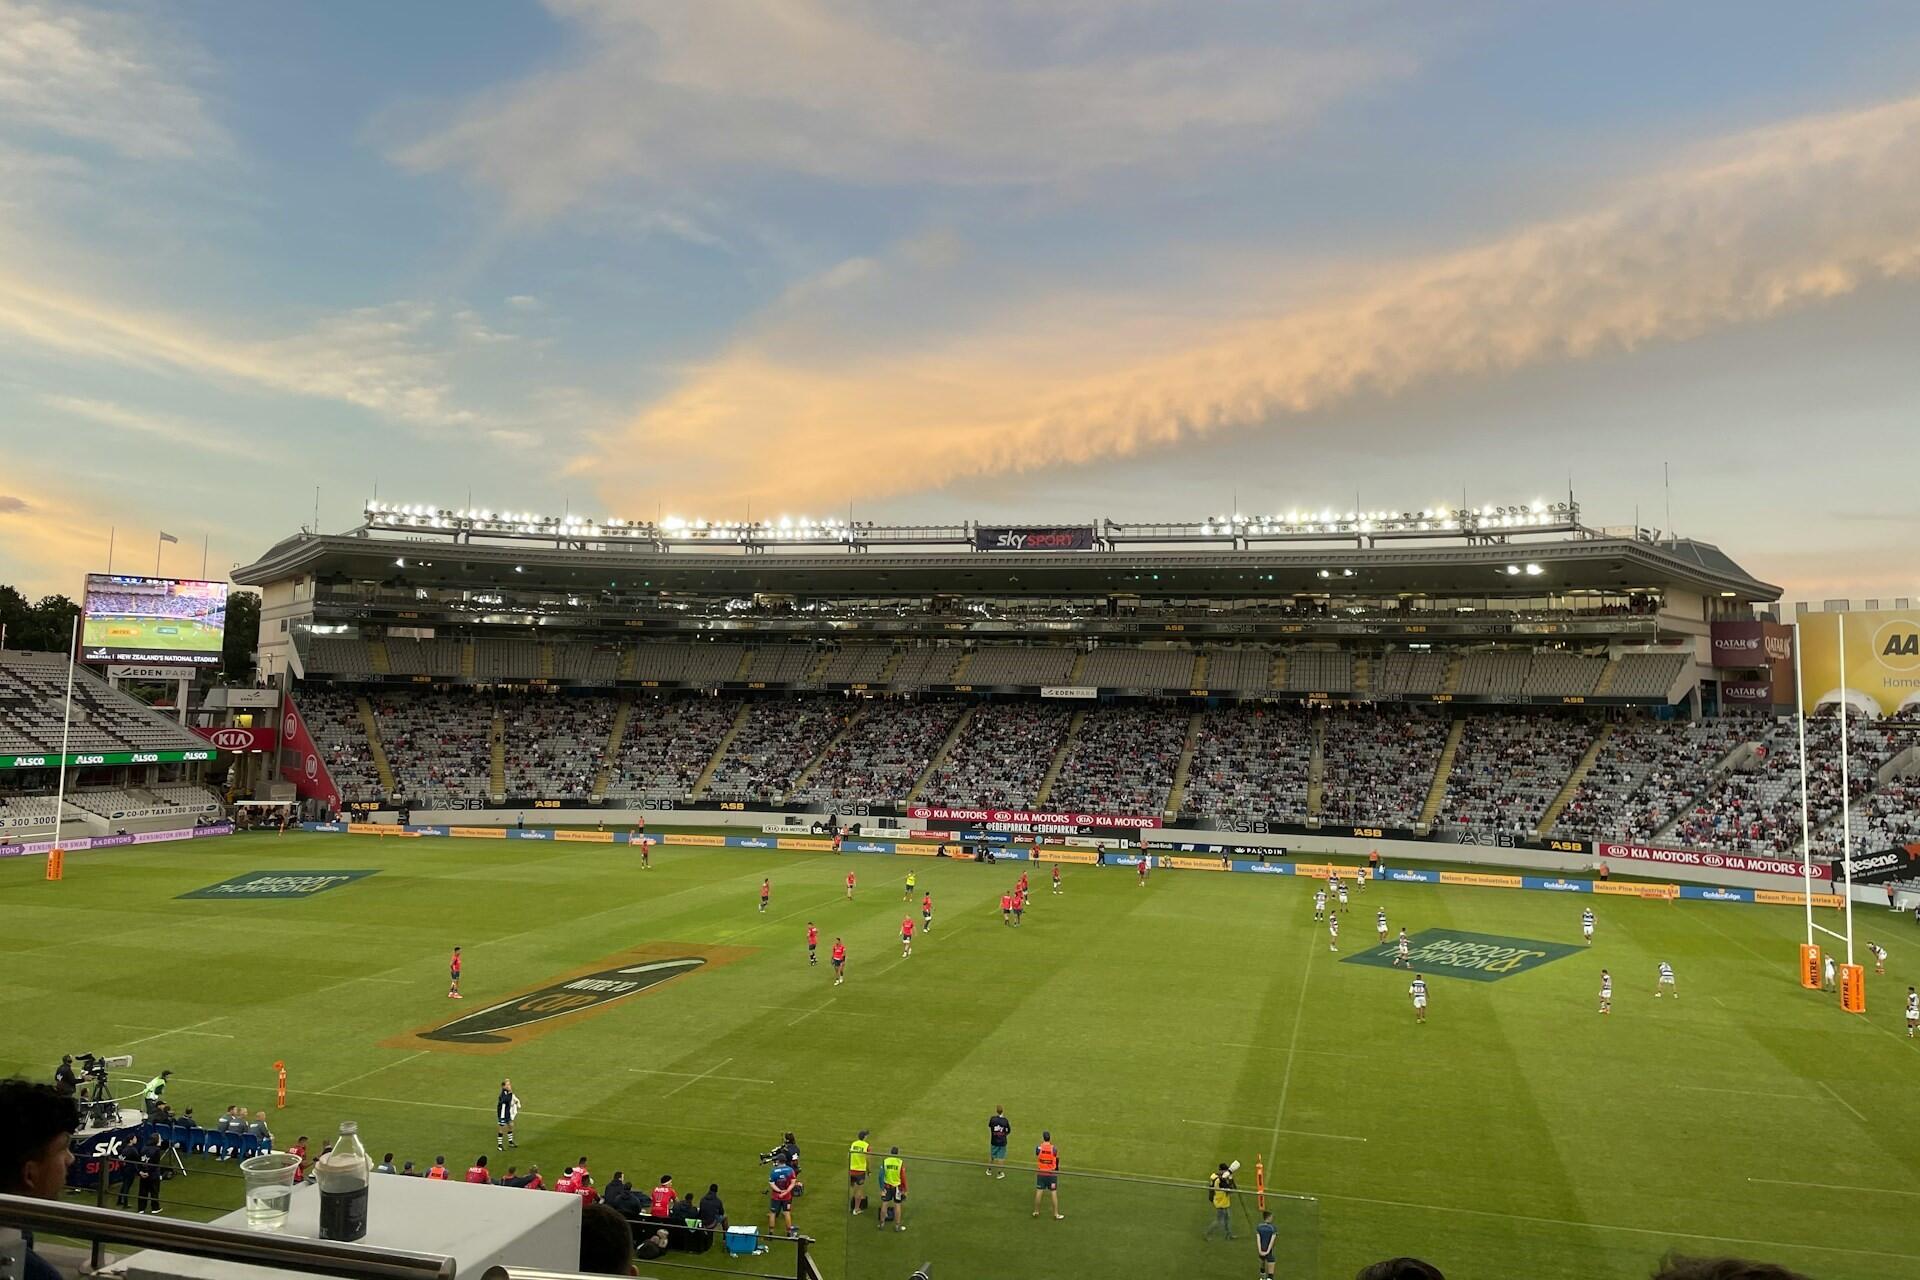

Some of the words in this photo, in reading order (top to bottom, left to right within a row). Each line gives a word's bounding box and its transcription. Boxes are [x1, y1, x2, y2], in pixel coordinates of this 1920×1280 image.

[997, 530, 1027, 549] sky
[1027, 534, 1072, 546] SPORT
[1715, 639, 1746, 649] QATAR
[1882, 634, 1919, 655] AA
[165, 669, 195, 677] PARK
[1883, 677, 1920, 688] Home
[1726, 687, 1755, 697] QATAR
[218, 734, 246, 745] KIA
[75, 755, 104, 764] ALSCO
[131, 754, 158, 762] ALSCO
[183, 752, 208, 760] ALSCO
[14, 757, 45, 766] ALSCO
[351, 802, 379, 811] ASB
[535, 800, 561, 808] ASB
[720, 802, 745, 811] ASB
[126, 810, 149, 818] CO-OP
[152, 808, 172, 816] TAXIS
[33, 816, 56, 825] 3000
[933, 809, 949, 818] KIA
[951, 811, 988, 820] MOTORS
[1014, 812, 1029, 822] KIA
[1032, 814, 1070, 823] MOTORS
[1096, 816, 1112, 826] KIA
[1114, 819, 1153, 828] MOTORS
[1354, 828, 1382, 837] ASB
[104, 837, 132, 845] DENTONS
[1551, 840, 1582, 851] ASB
[1631, 848, 1650, 859] KIA
[1652, 851, 1700, 864] MOTORS
[1704, 856, 1722, 865] KIA
[1726, 858, 1745, 869] KIA
[1747, 860, 1796, 874] MOTORS
[1479, 877, 1509, 885] Industries
[1634, 885, 1666, 893] Industries
[1757, 893, 1779, 901] Nelson
[1781, 894, 1796, 902] Pine
[1422, 940, 1531, 959] BARFOOT
[1810, 960, 1818, 986] MITRE
[1842, 968, 1849, 979] 10
[1842, 981, 1850, 1009] MITRE
[93, 1137, 122, 1157] sk
